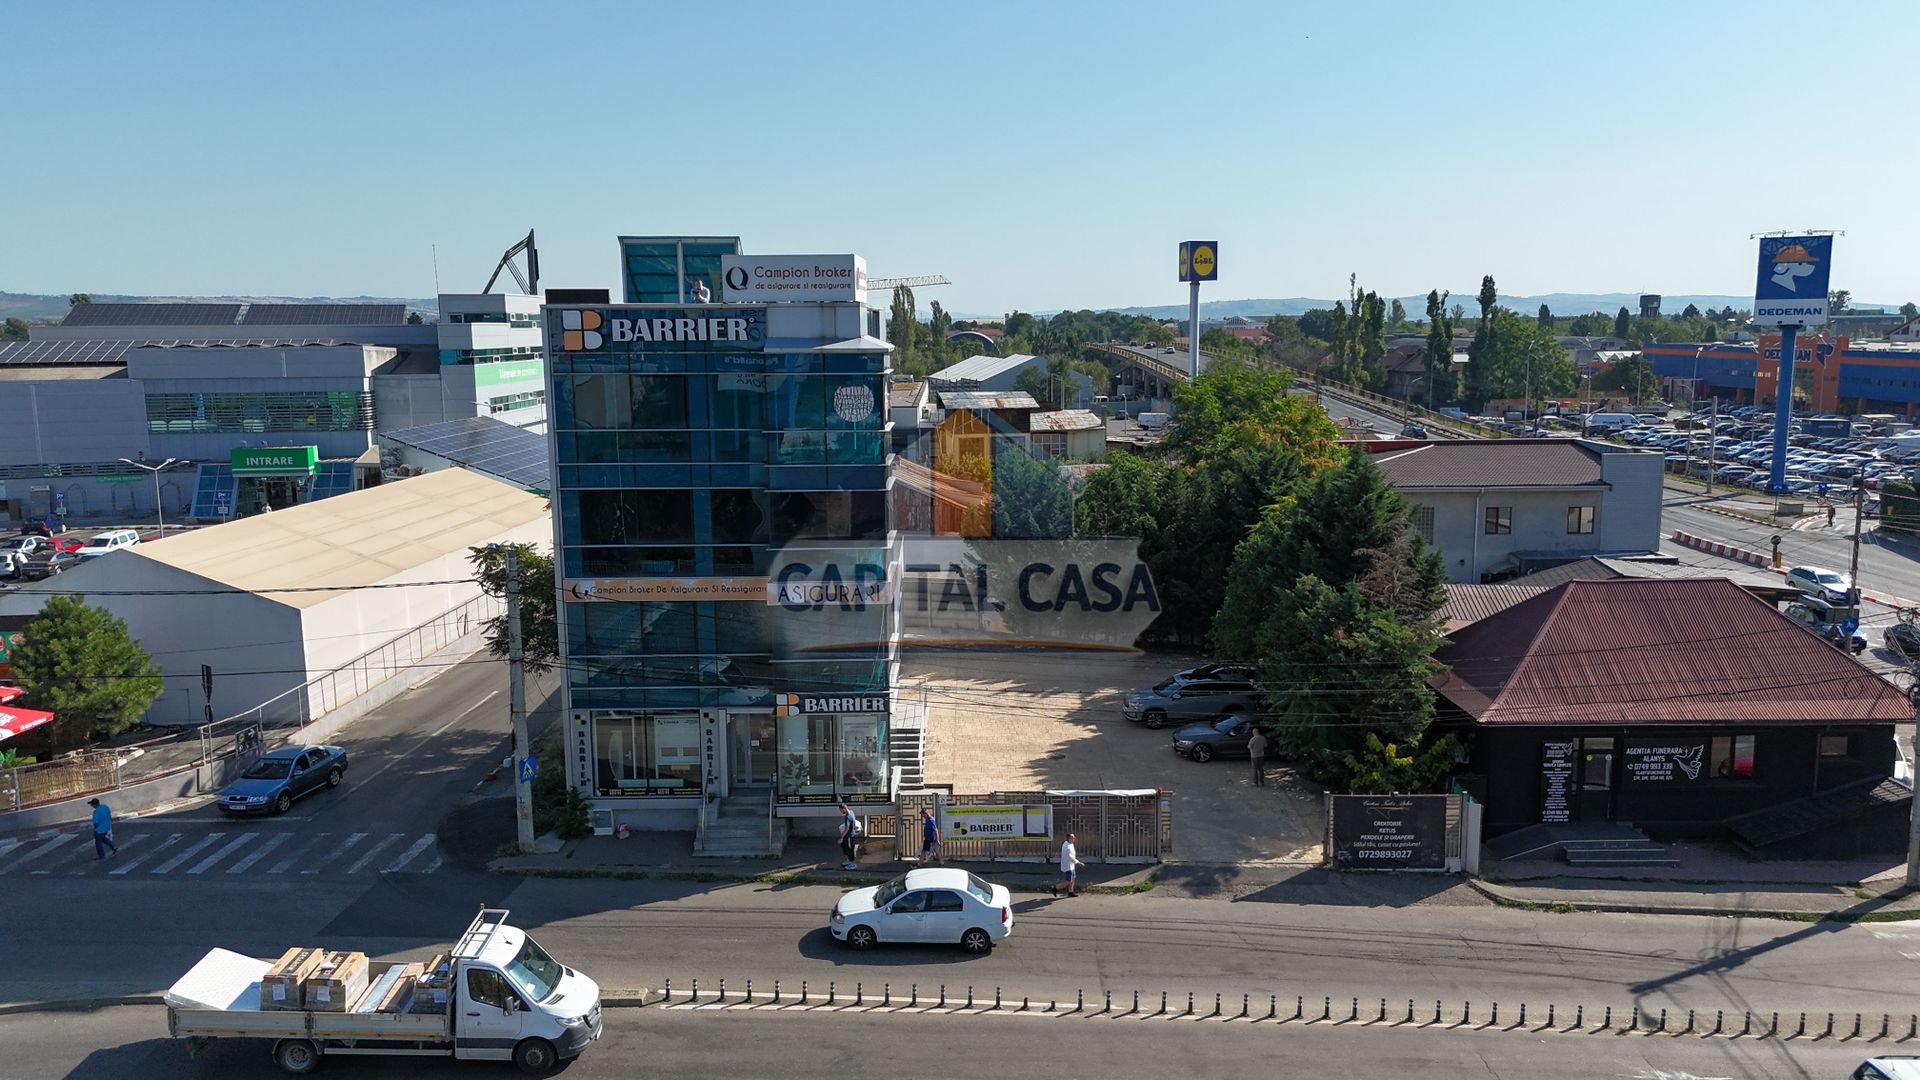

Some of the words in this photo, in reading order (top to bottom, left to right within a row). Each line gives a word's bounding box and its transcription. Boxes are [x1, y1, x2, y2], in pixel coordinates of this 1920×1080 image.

[754, 266, 809, 280] Campion
[814, 266, 852, 278] Broker
[1758, 308, 1822, 316] DEDEMAN
[611, 318, 749, 342] BARRIER
[1763, 349, 1812, 361] DEAN
[246, 456, 294, 466] INTRARE
[590, 586, 626, 596] Campion
[670, 585, 708, 594] Asigurare
[778, 585, 880, 602] ASIGURARI
[805, 698, 884, 712] BARRIER
[578, 731, 588, 786] BARRIER
[970, 824, 1013, 832] BARRIER
[1358, 850, 1412, 858] 0729893027
